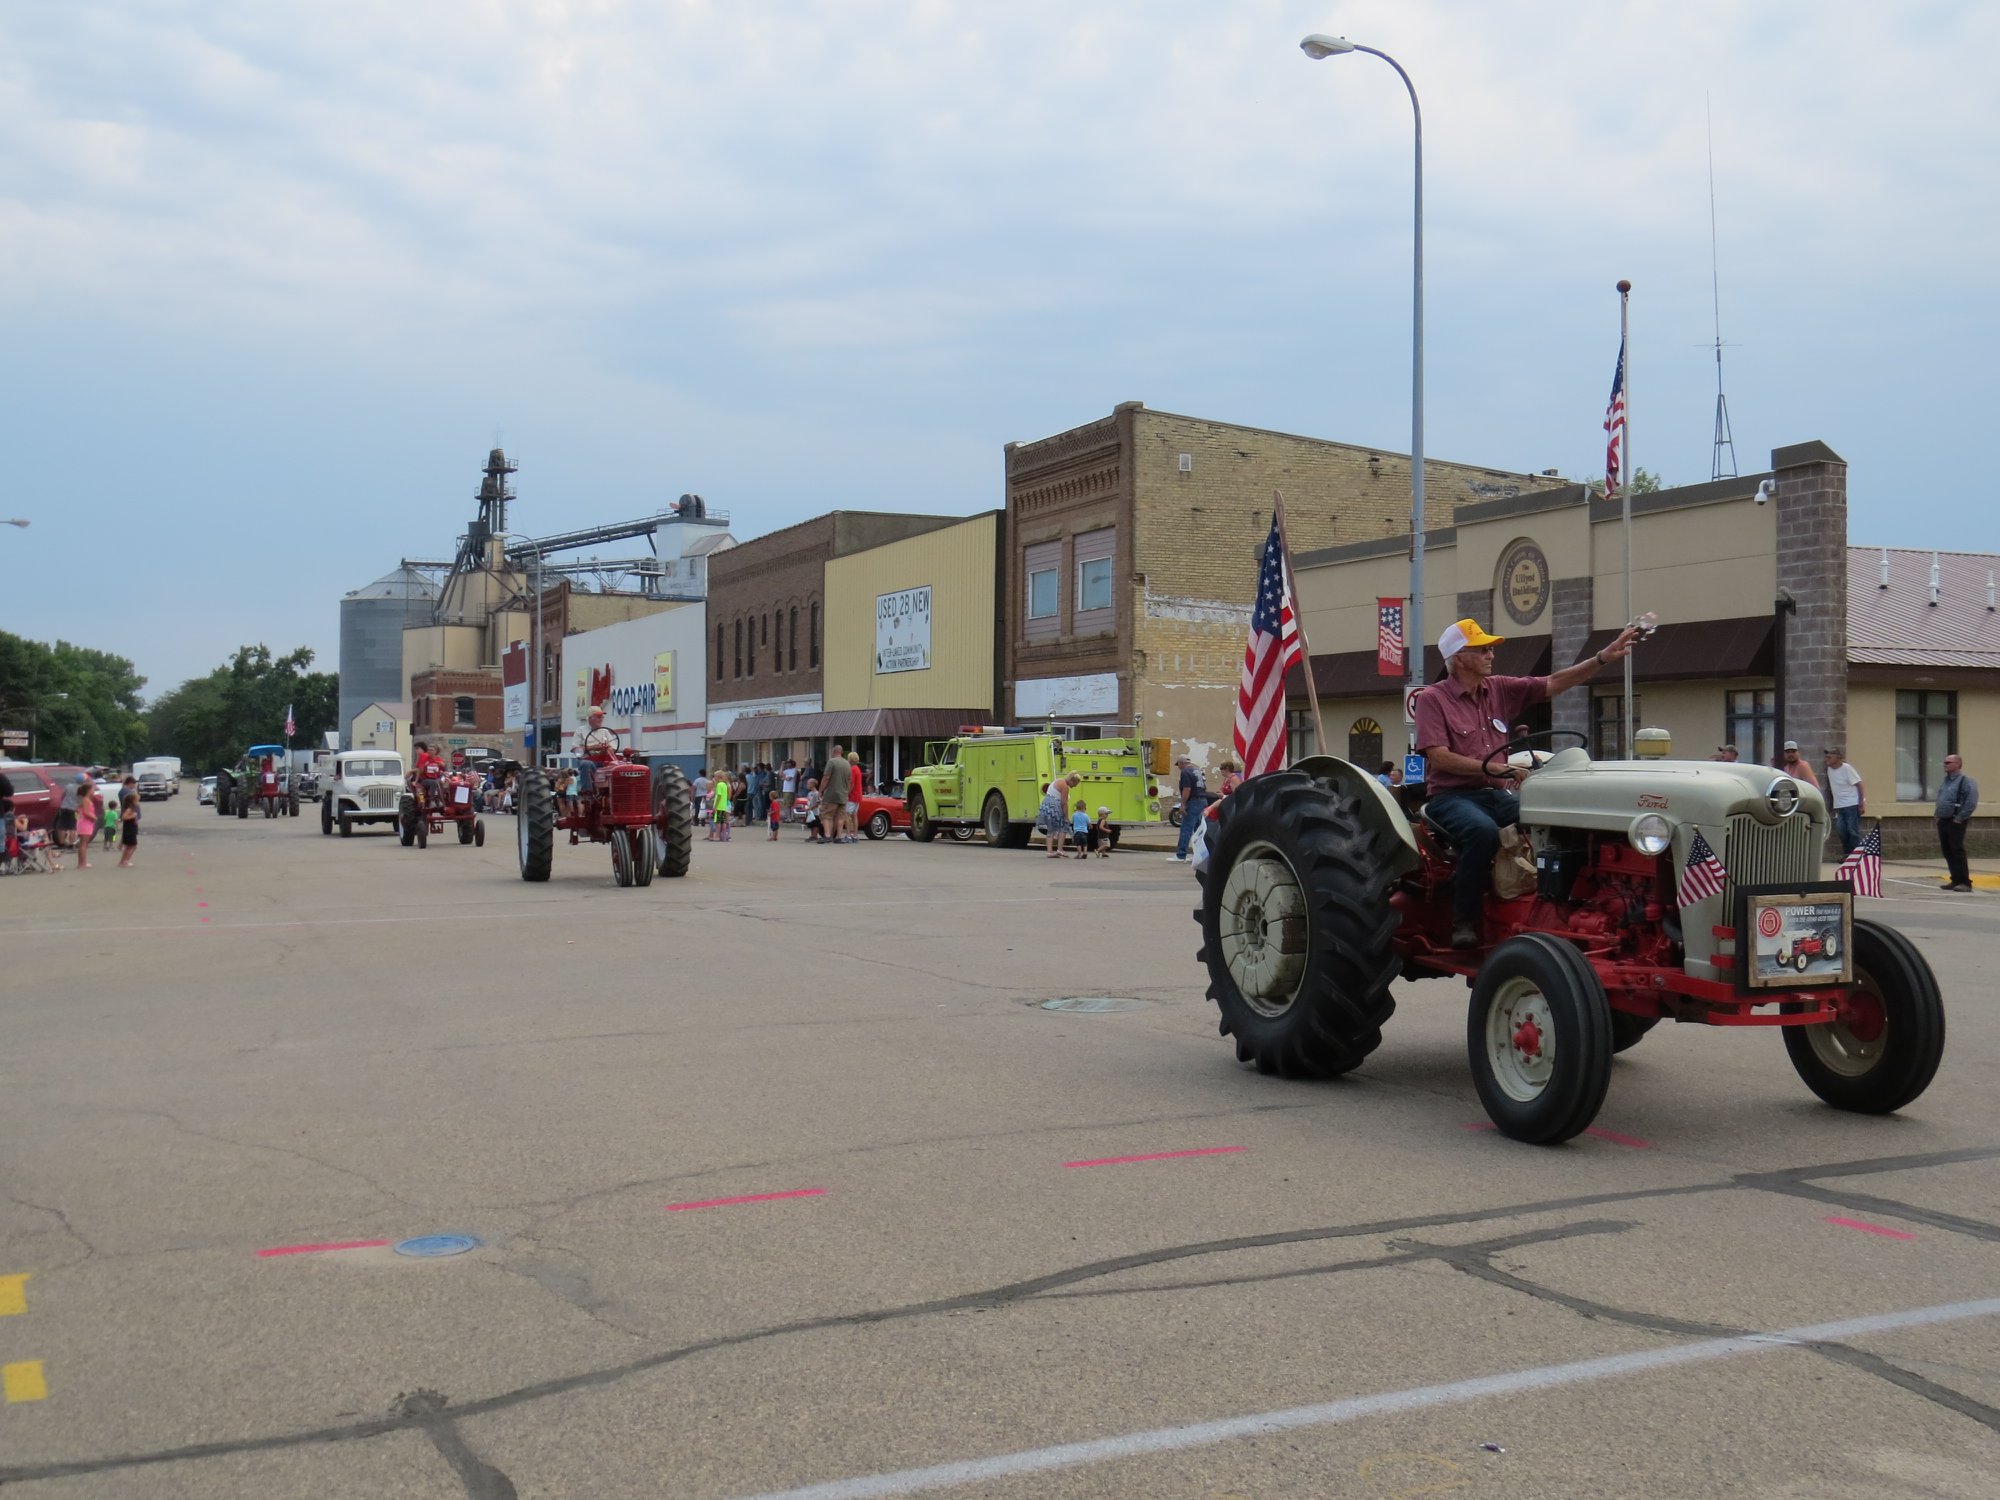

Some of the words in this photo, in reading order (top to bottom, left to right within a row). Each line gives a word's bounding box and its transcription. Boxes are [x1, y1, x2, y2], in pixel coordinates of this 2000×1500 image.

[877, 596, 897, 620] USED
[899, 594, 910, 616] 2B
[912, 590, 930, 614] NEW
[1379, 645, 1402, 666] WELCOME
[612, 686, 636, 717] FOOD
[637, 682, 656, 713] FAIR
[1637, 793, 1670, 809] Ford
[1785, 905, 1815, 916] POWER
